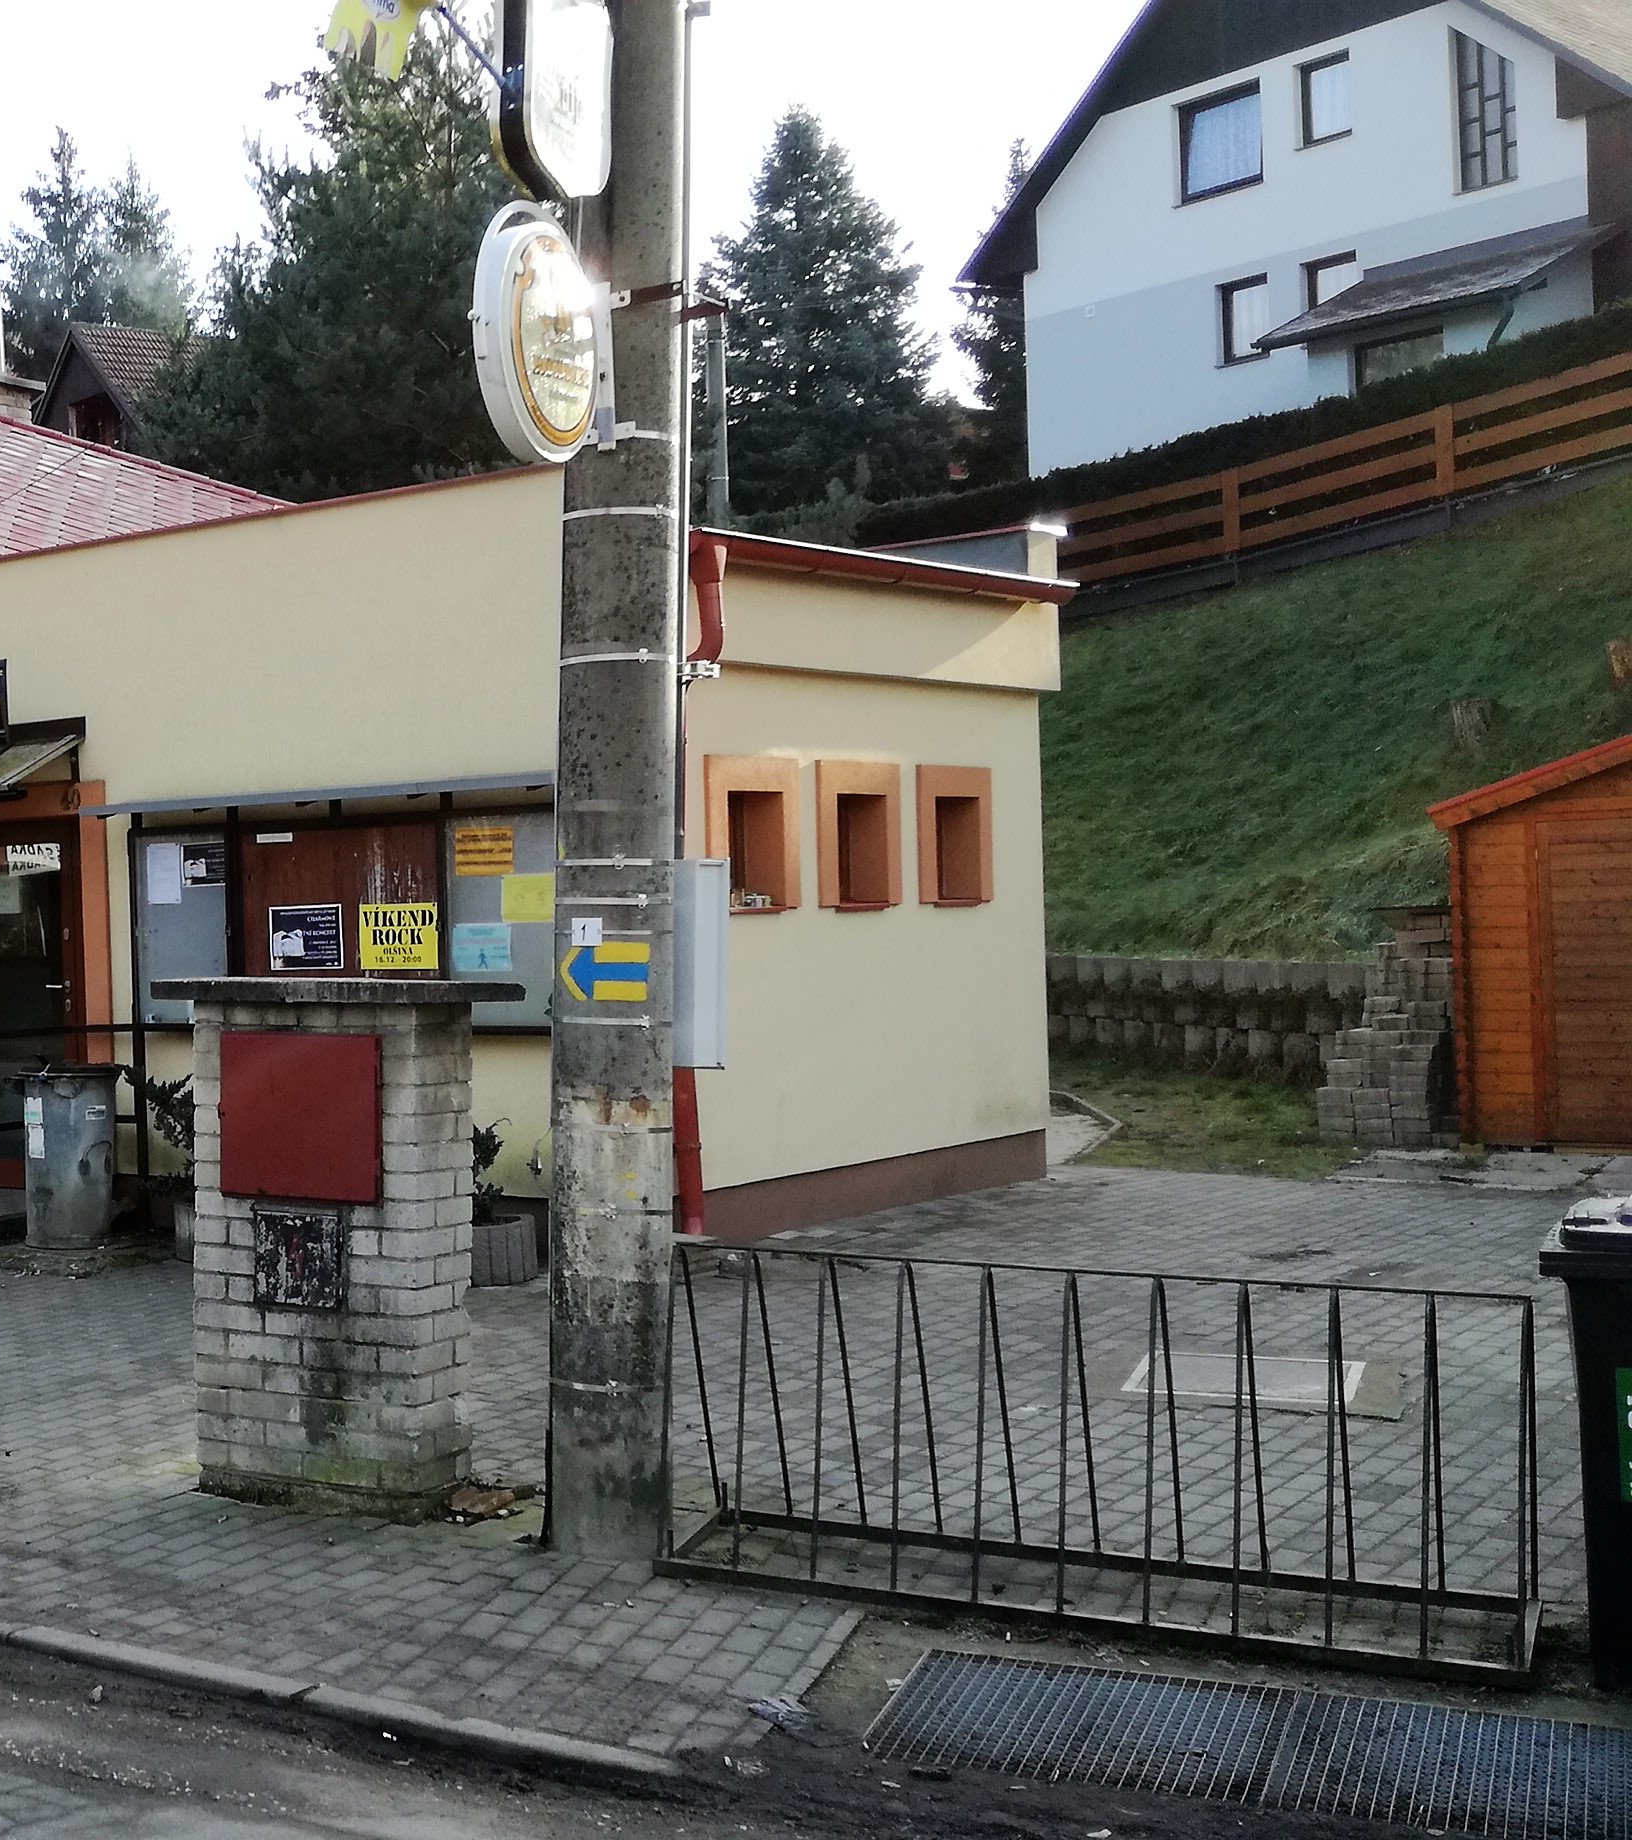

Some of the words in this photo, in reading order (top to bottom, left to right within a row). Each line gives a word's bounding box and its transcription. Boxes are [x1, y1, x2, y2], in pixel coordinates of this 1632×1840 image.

[362, 906, 434, 928] VÍKEND
[372, 928, 423, 946] ROCK
[581, 924, 586, 941] 1
[382, 945, 414, 956] OLŠINA
